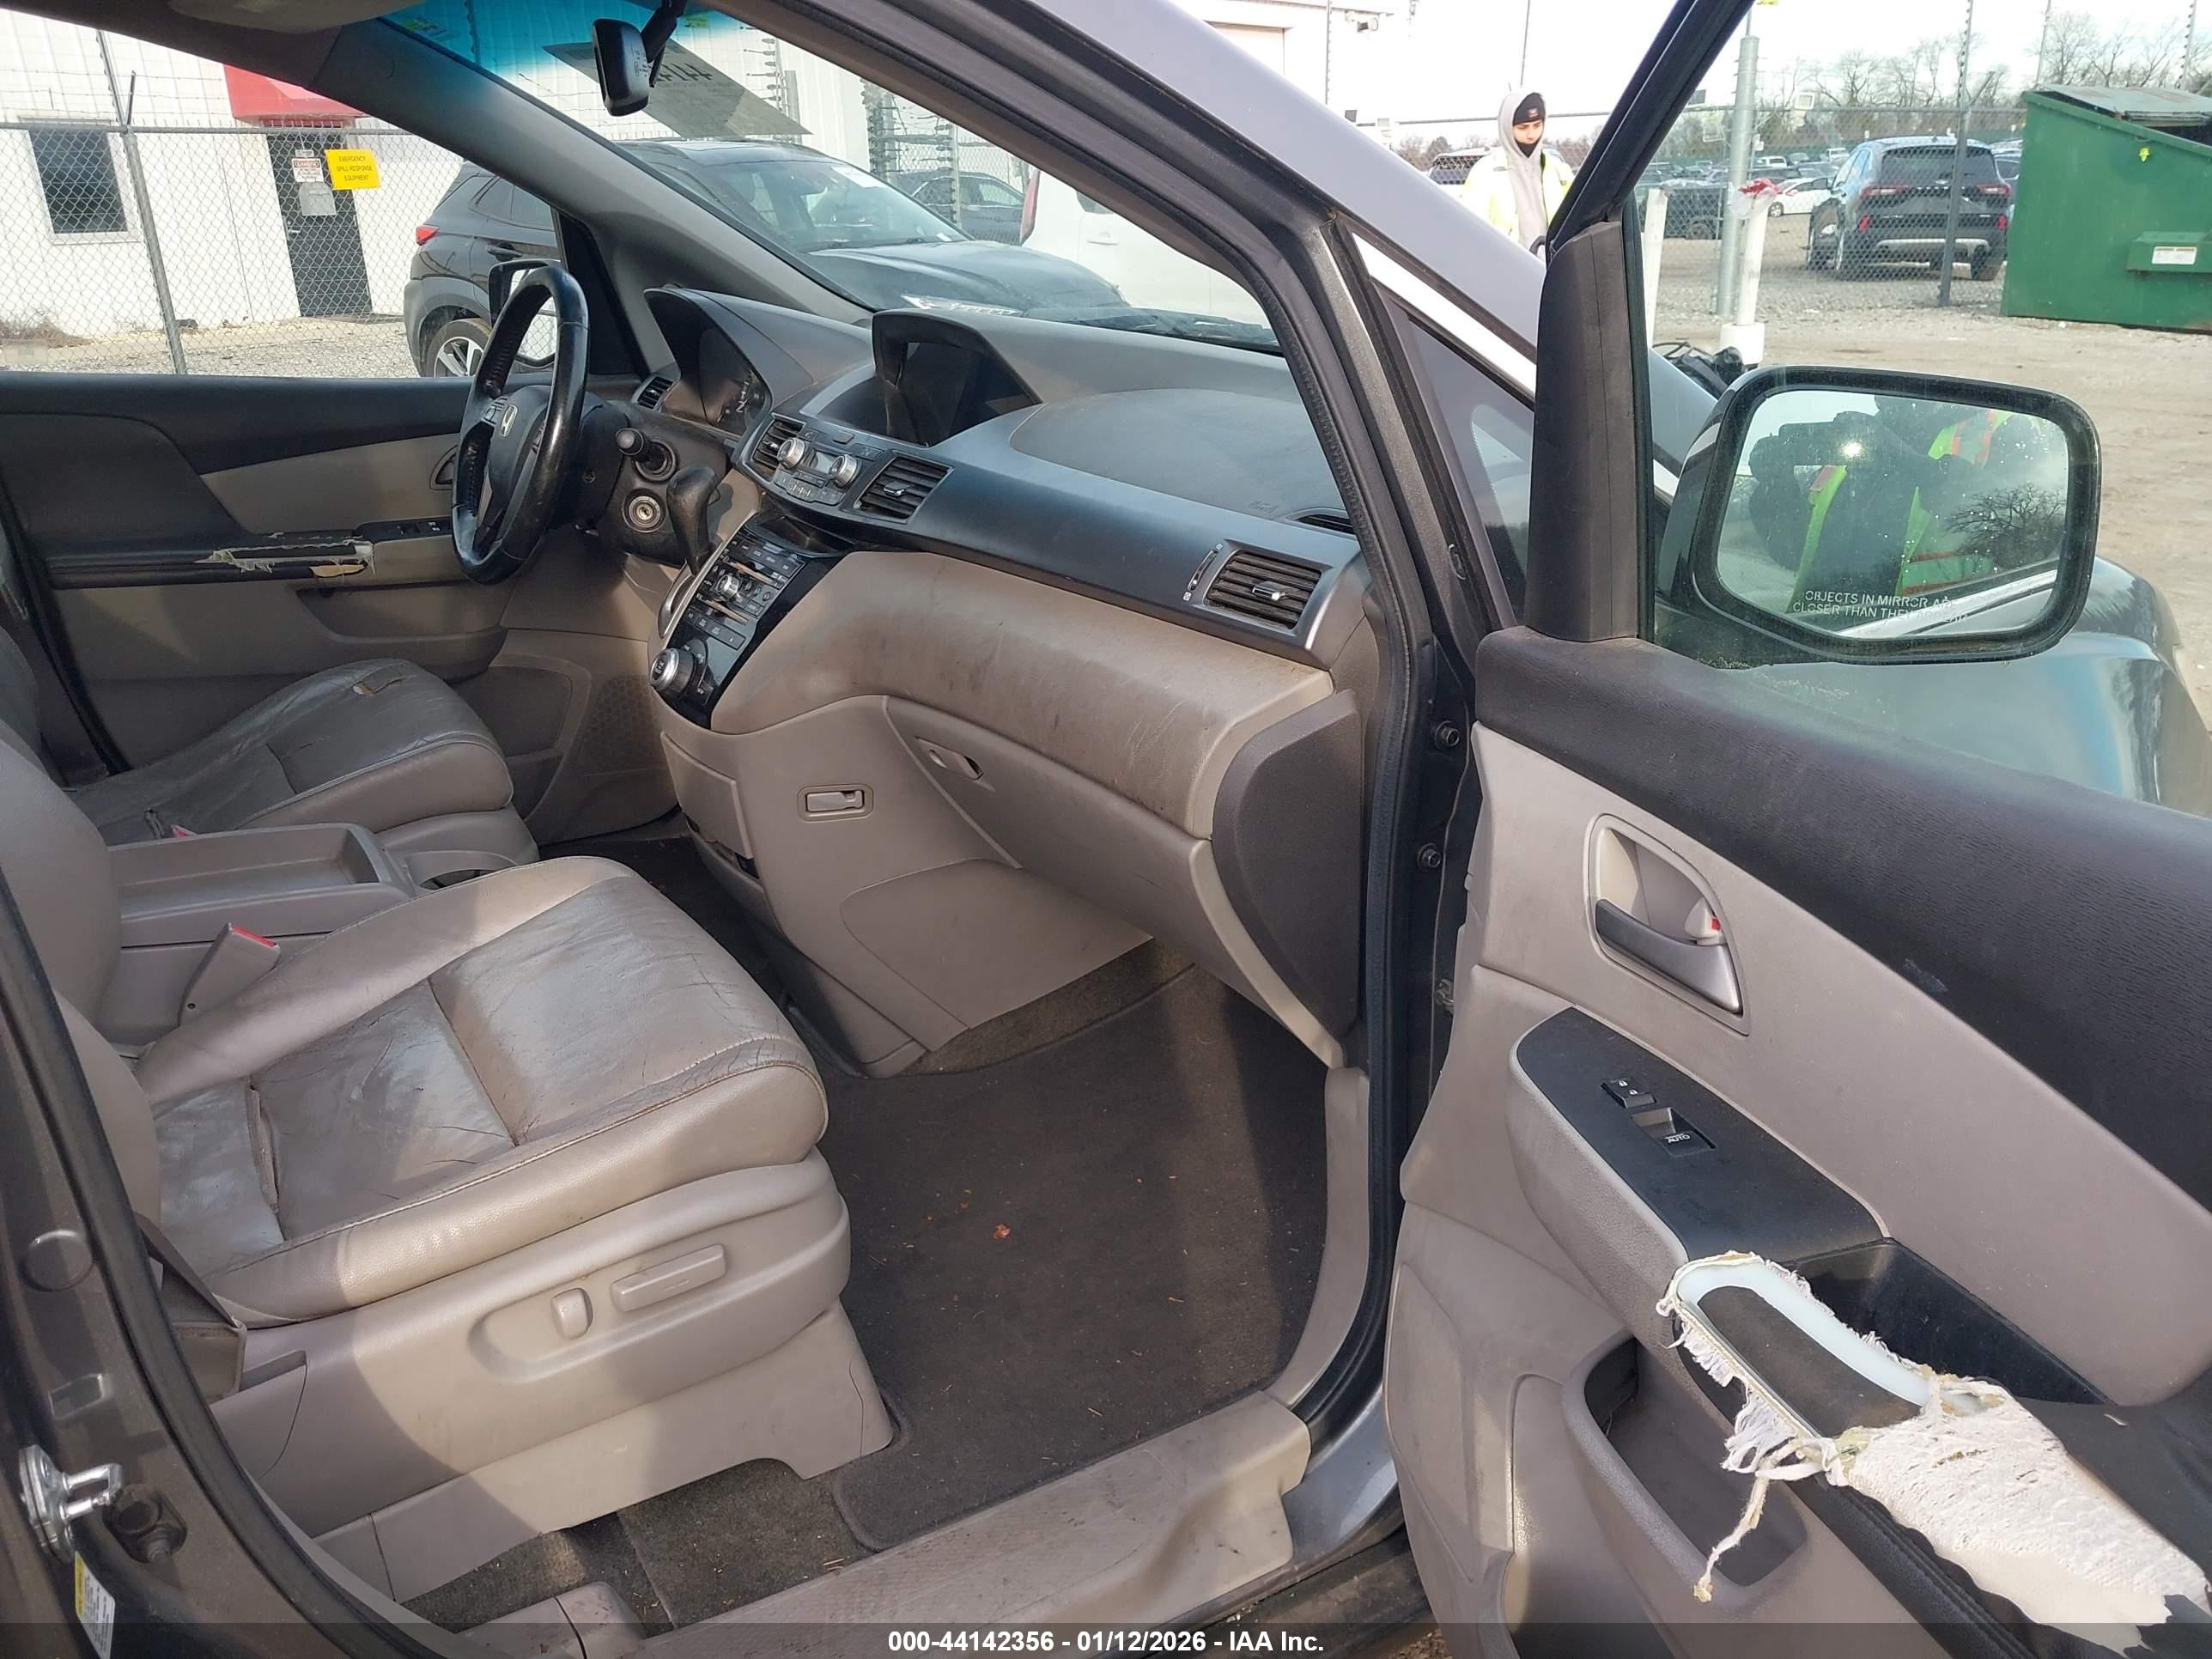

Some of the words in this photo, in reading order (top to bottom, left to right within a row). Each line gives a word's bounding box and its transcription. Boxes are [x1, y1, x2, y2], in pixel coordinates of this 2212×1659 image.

[1805, 590, 1858, 604] OBJECTS
[1862, 593, 1875, 605] IN
[1877, 594, 1929, 608] MIRROR
[1792, 601, 1840, 615] CLOSER
[1844, 605, 1877, 617] THAN
[1881, 608, 1913, 620] THEY
[1665, 1133, 1691, 1143] AUTO
